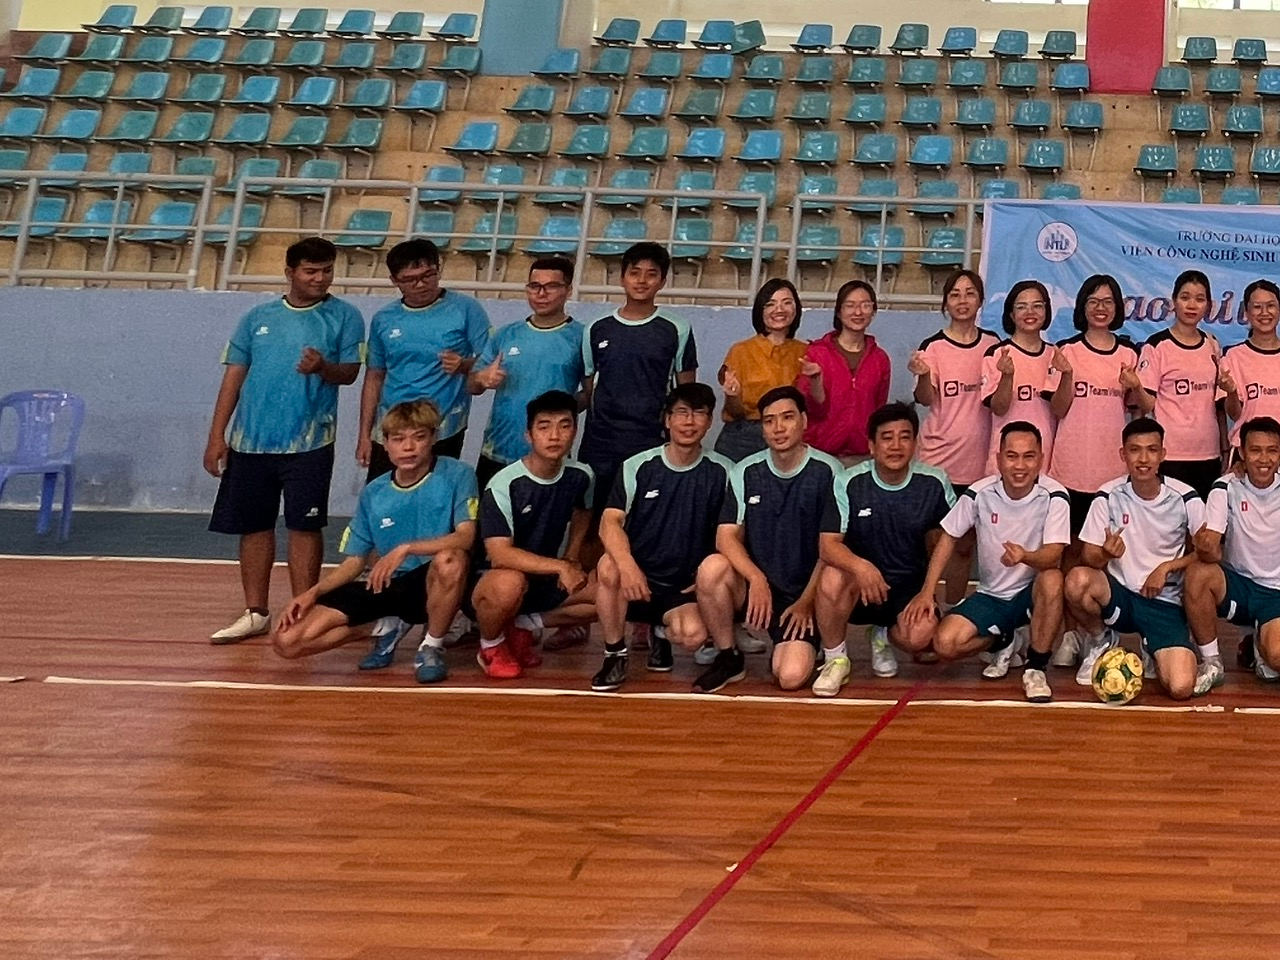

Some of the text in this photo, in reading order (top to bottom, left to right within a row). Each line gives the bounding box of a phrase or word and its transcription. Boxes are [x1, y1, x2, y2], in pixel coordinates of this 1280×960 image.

[1156, 244, 1197, 260] CÔNG
[1199, 246, 1240, 263] NGHỆ
[1242, 250, 1277, 263] SINH
